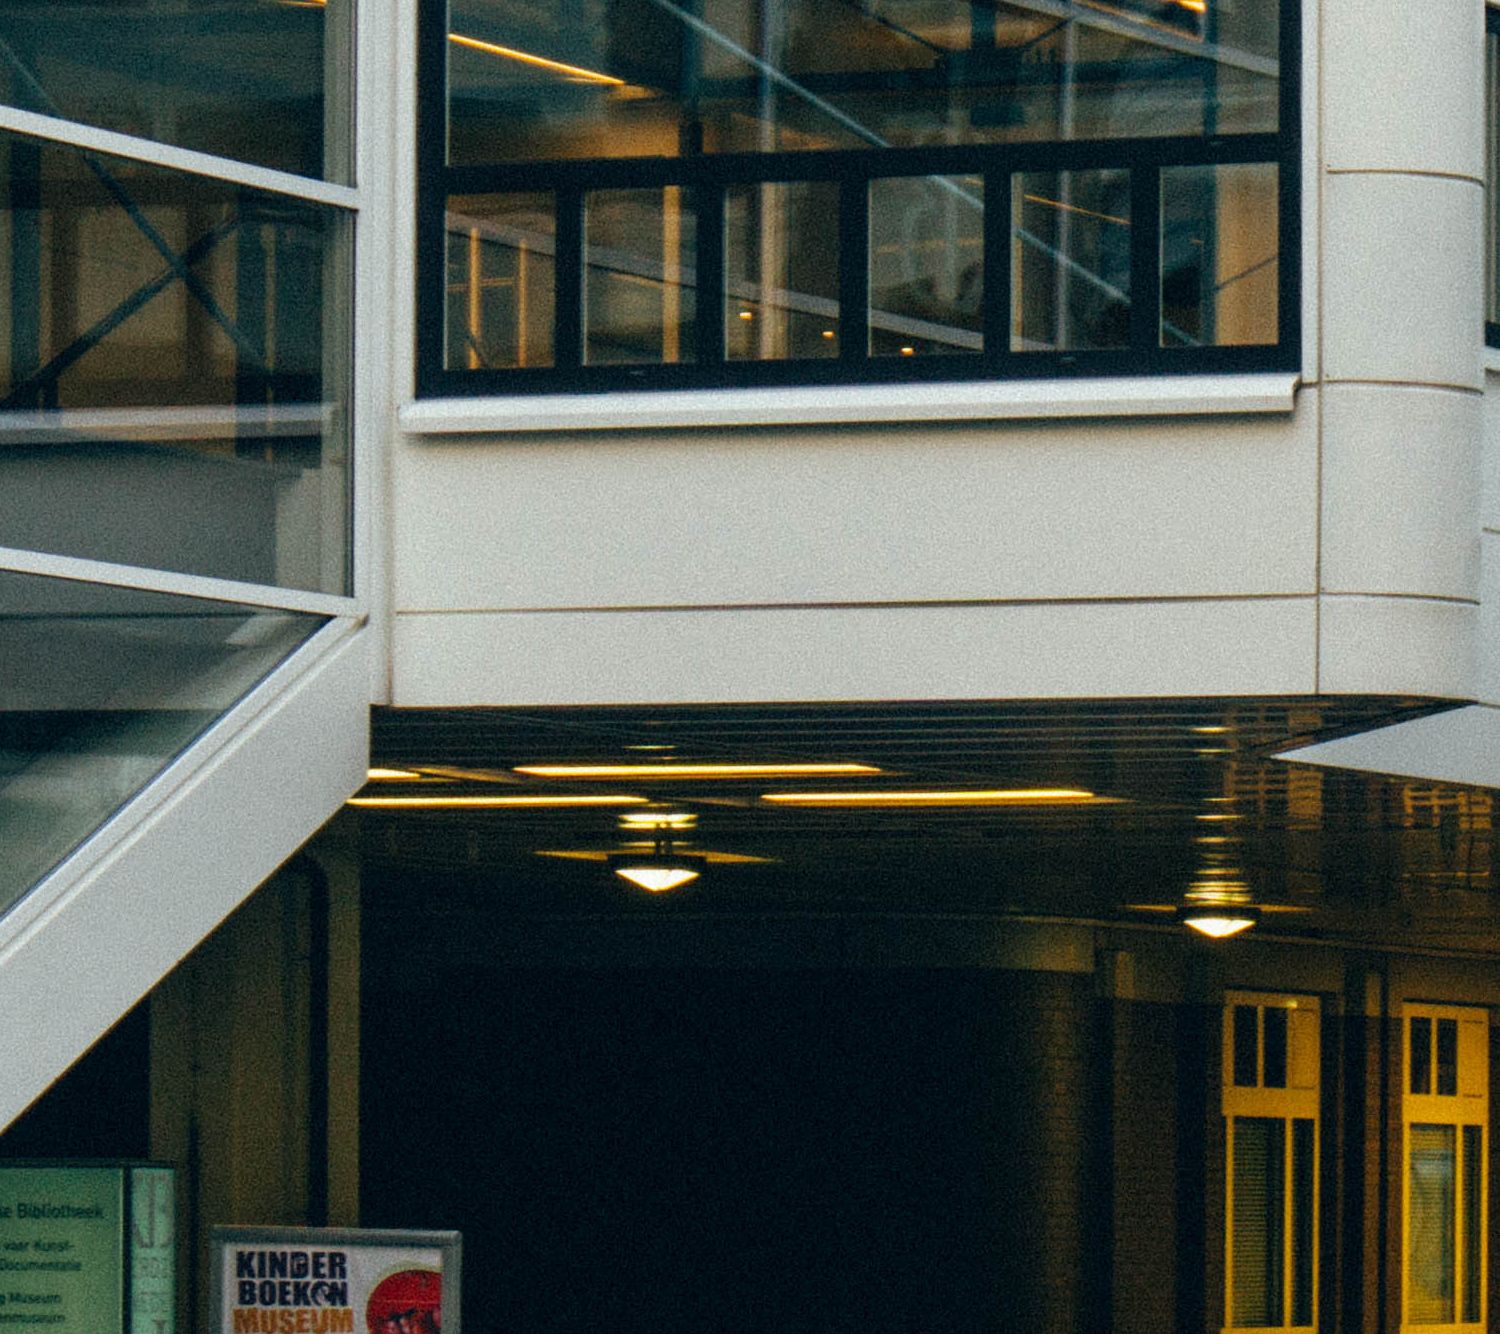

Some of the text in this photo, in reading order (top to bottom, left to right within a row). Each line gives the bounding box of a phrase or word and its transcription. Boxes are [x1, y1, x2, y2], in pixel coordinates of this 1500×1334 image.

[17, 1202, 104, 1218] Bibliotheek
[236, 1251, 347, 1279] KINDER
[8, 1291, 62, 1304] Museum
[233, 1308, 354, 1334] MUSEUM
